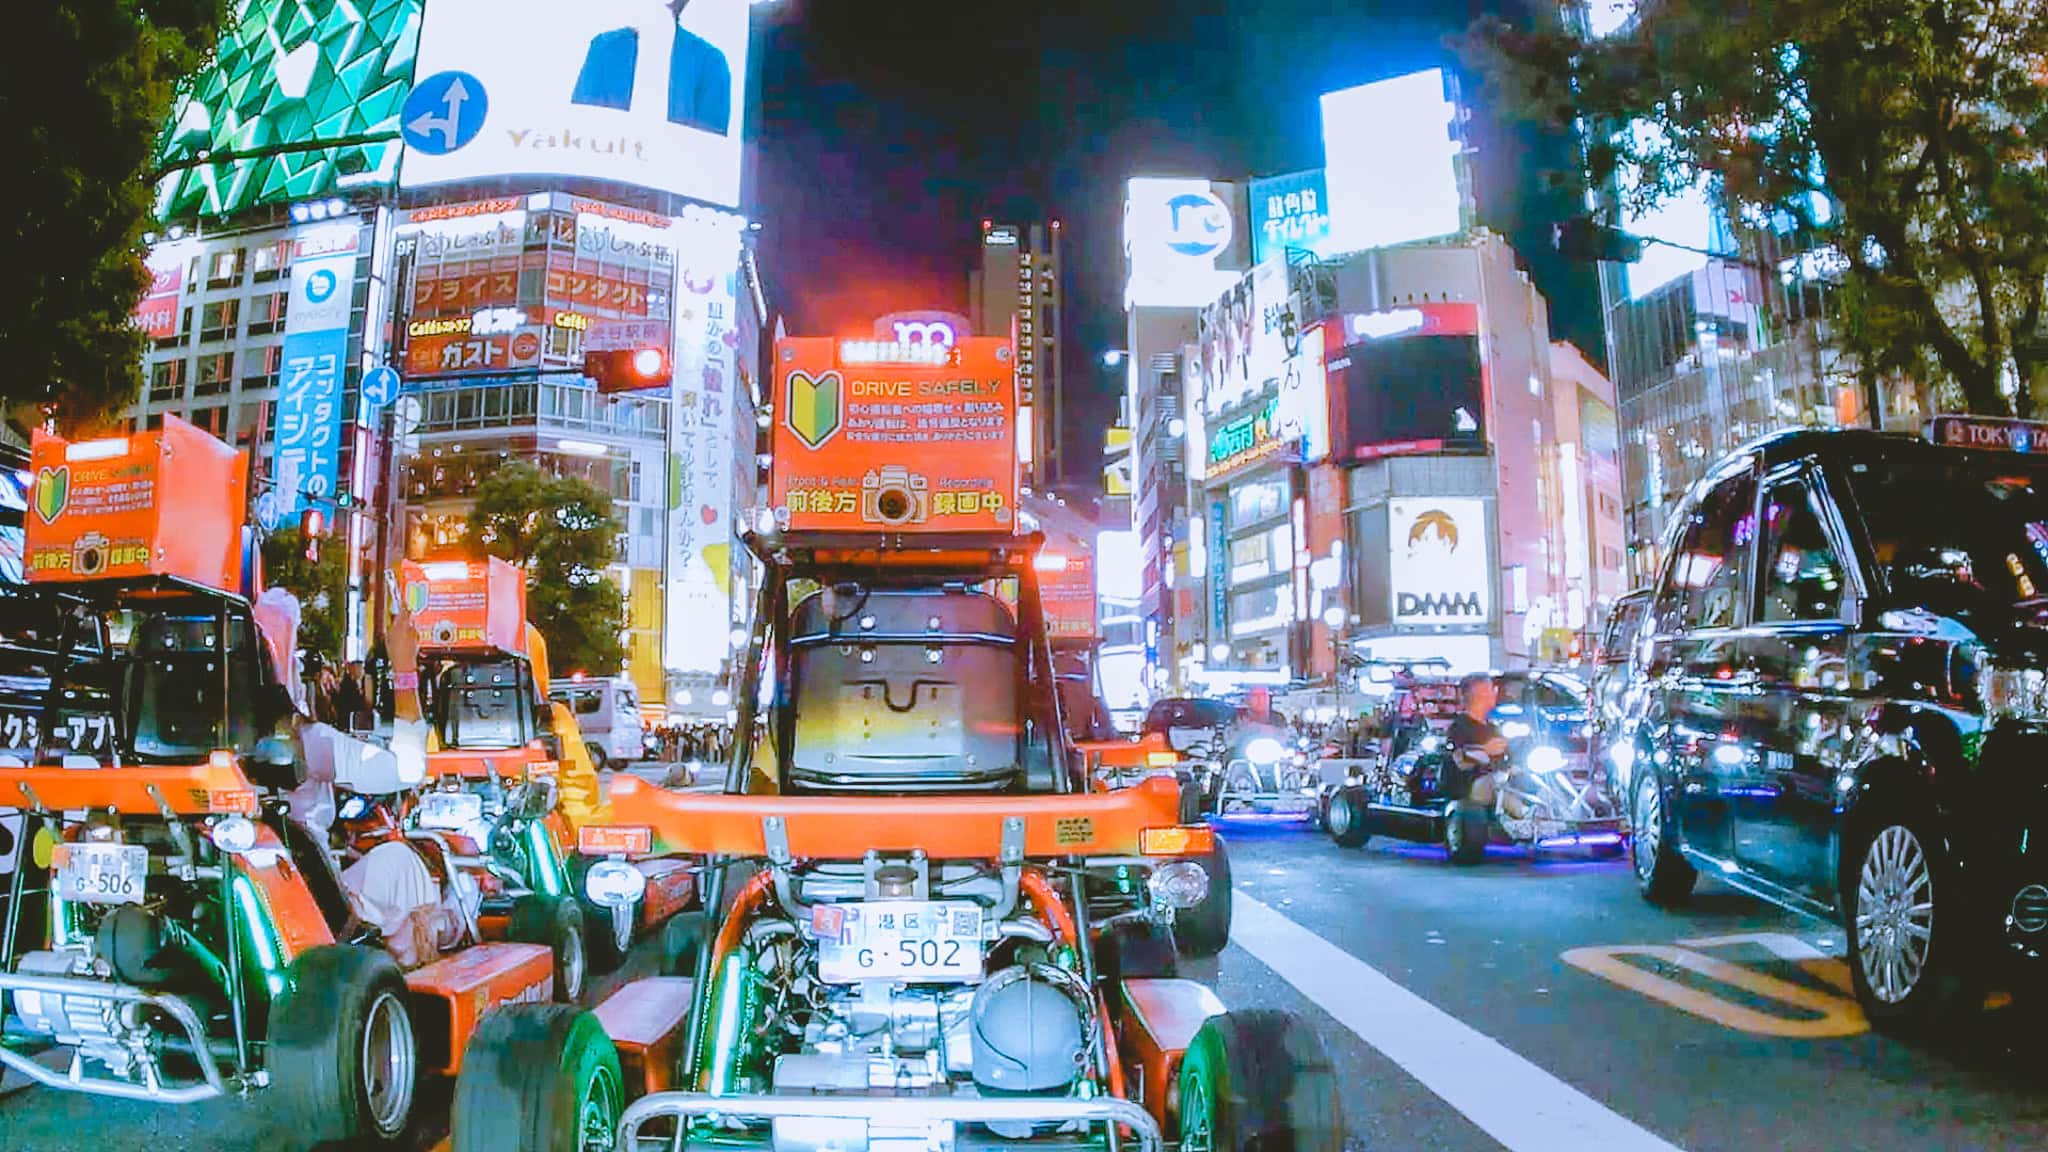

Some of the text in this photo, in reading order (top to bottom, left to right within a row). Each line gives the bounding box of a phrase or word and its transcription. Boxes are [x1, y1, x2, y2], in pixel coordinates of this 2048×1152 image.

[396, 239, 416, 256] 9F
[549, 273, 645, 307] コンタクト
[440, 340, 504, 368] ガスト
[851, 379, 1001, 396] DRIVE SAFELY
[308, 353, 336, 497] コンタクトの
[786, 490, 857, 514] 前後方
[932, 491, 1004, 515] 録画中
[1397, 591, 1483, 617] DMM
